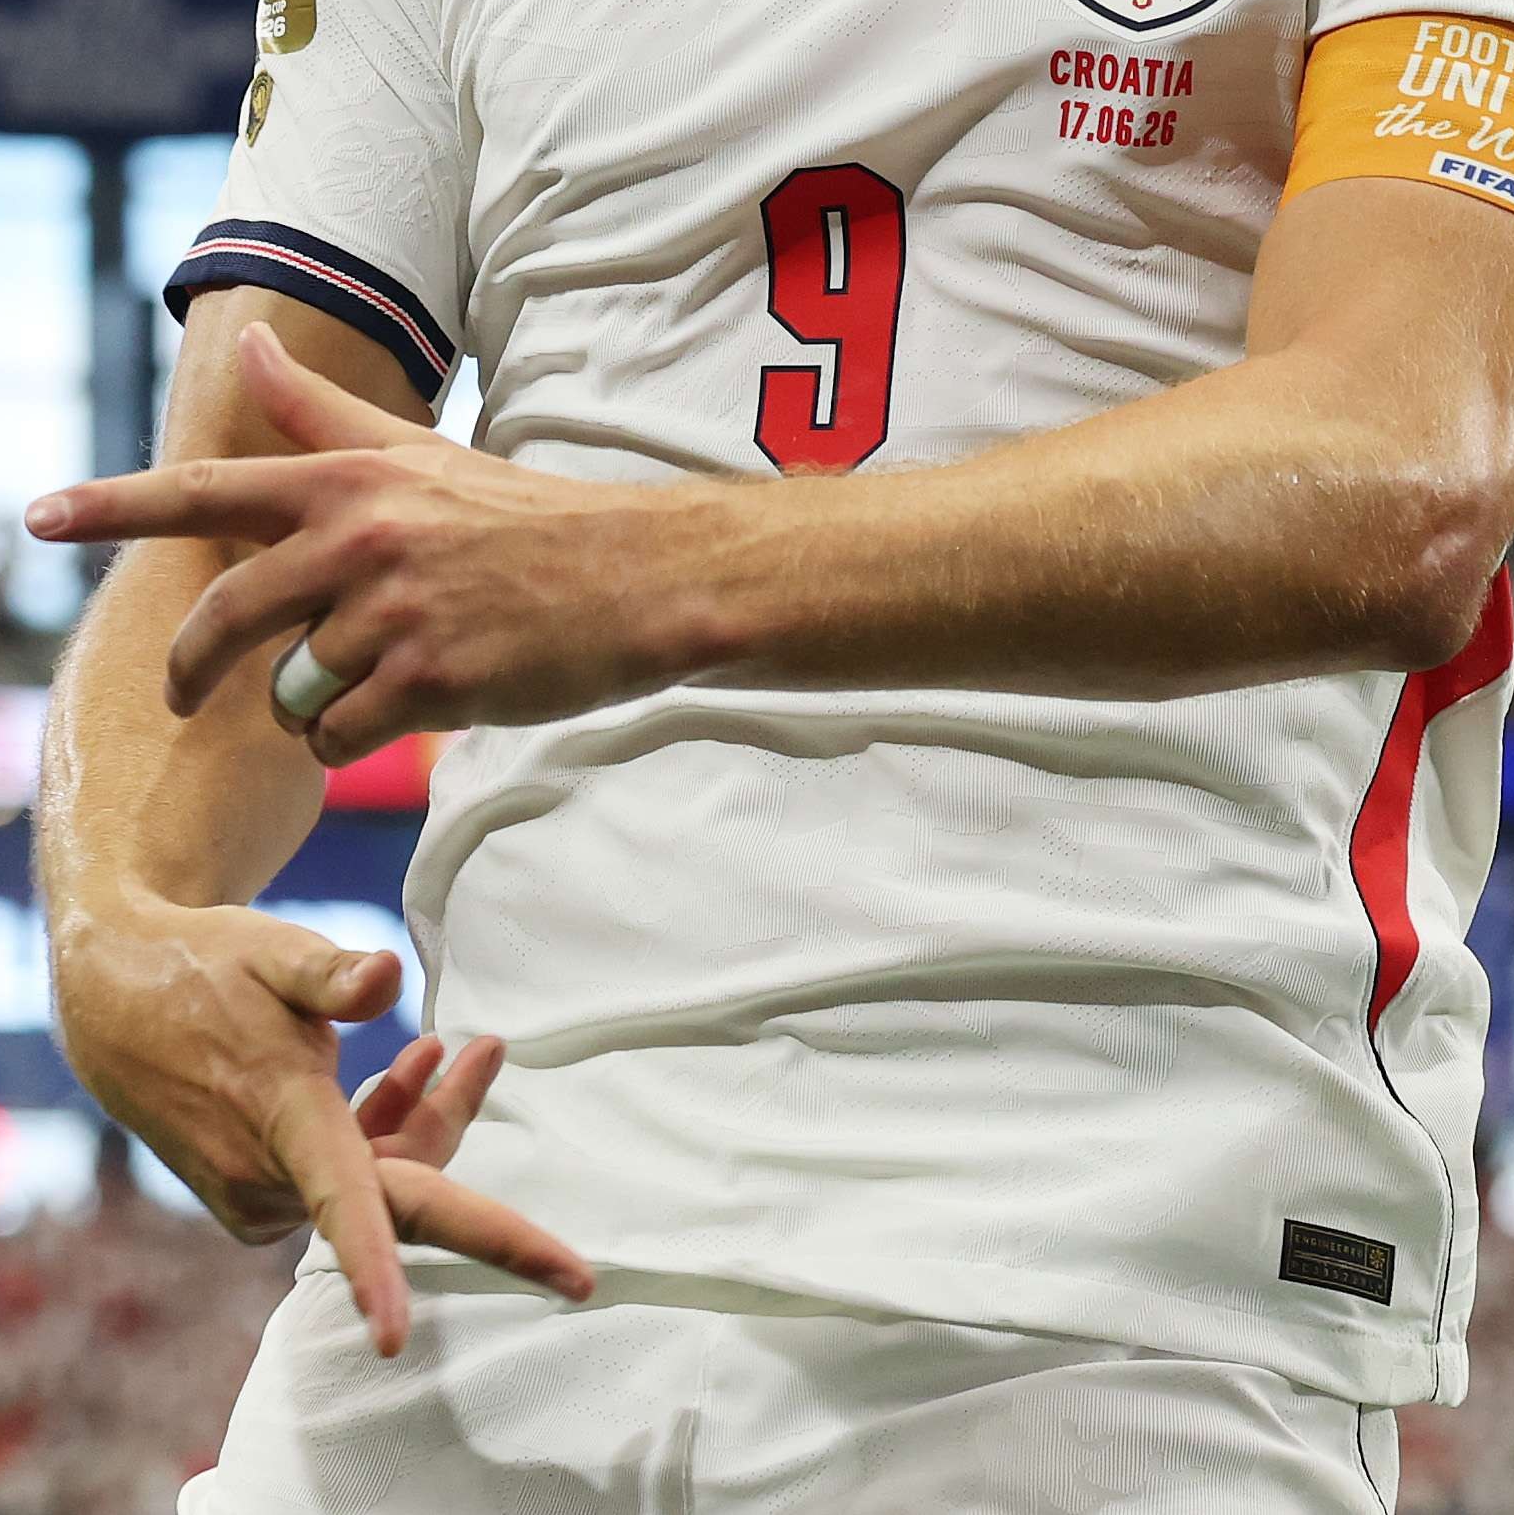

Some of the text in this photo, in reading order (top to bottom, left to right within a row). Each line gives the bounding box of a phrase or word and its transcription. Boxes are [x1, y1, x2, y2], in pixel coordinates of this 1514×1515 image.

[1049, 50, 1194, 97] CROATIA
[1058, 100, 1178, 147] 17.06.26
[1373, 100, 1462, 140] the
[753, 162, 907, 478] 9
